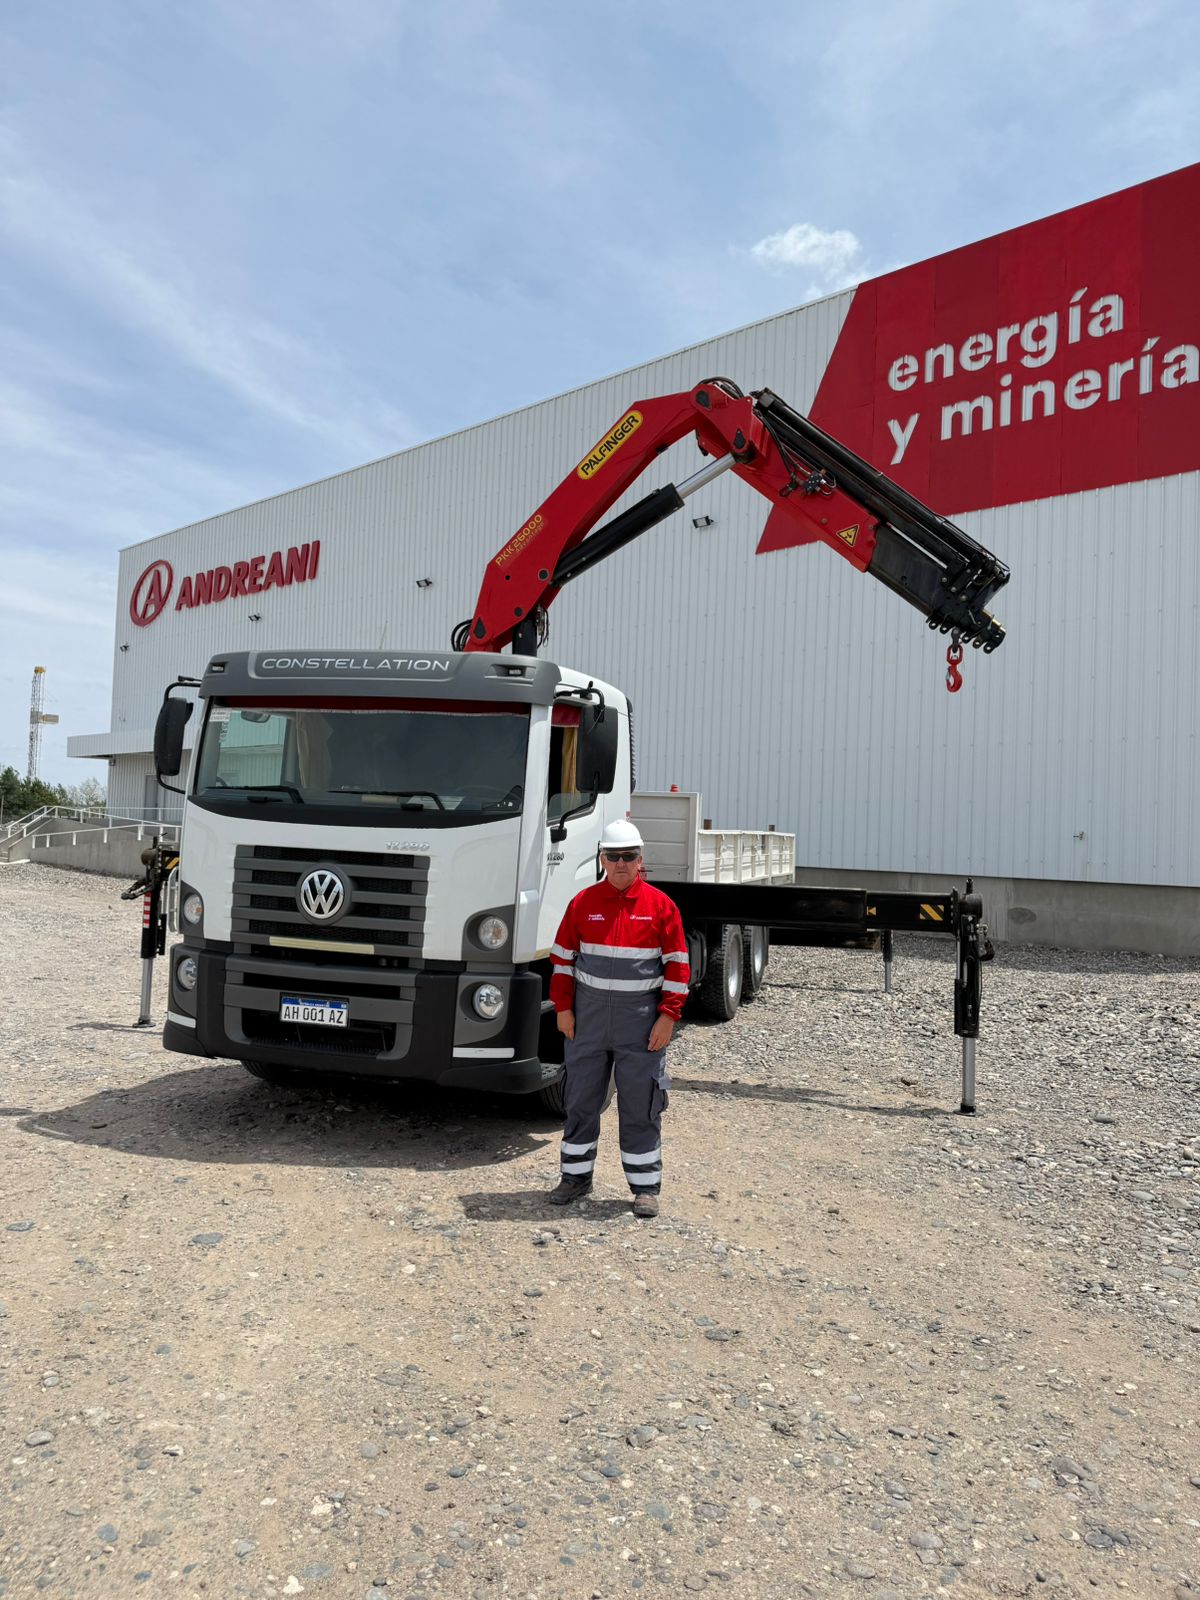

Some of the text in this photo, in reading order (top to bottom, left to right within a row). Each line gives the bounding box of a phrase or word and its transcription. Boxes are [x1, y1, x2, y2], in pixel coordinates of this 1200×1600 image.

[887, 286, 1124, 392] energía
[886, 336, 1200, 465] y minería
[580, 414, 640, 476] PALFINGER
[175, 540, 321, 612] ANDREANI
[261, 658, 450, 672] CONSTELLATION
[283, 1006, 344, 1024] AH 001 AZ
